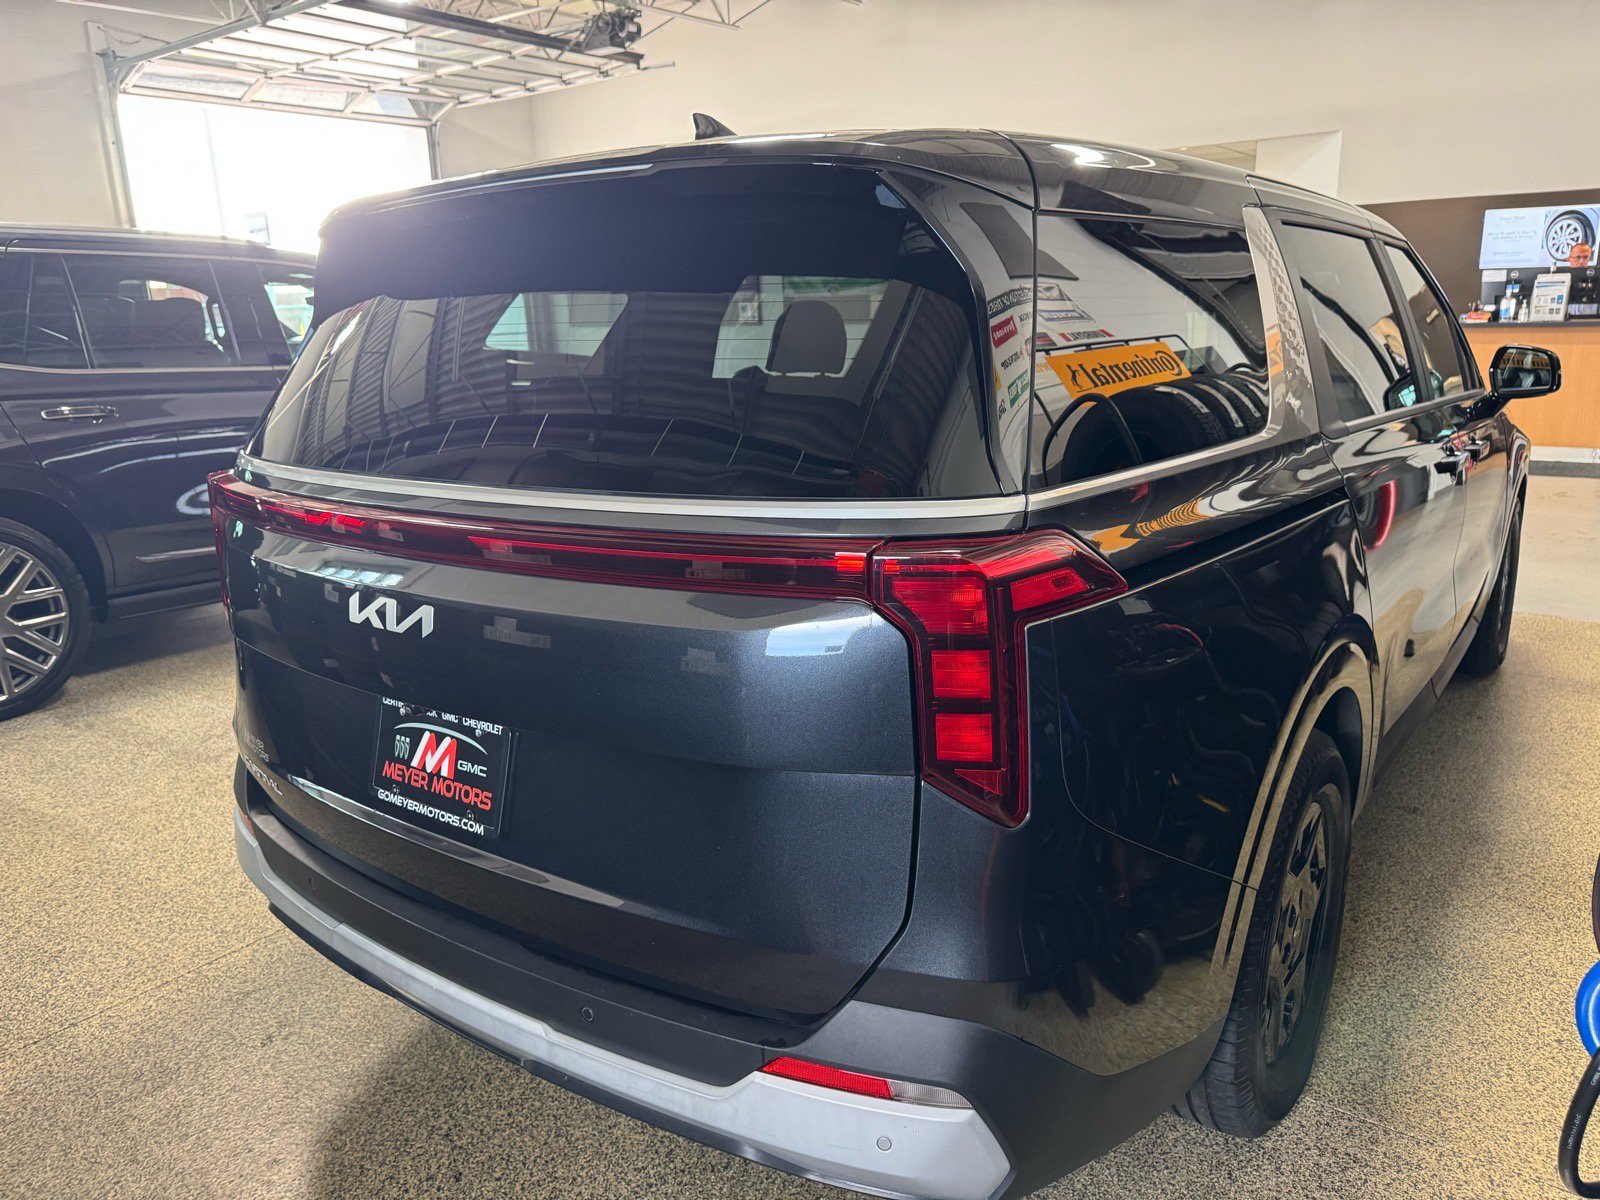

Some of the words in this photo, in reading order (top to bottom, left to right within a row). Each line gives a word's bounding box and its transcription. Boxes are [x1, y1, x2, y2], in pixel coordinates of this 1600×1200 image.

[462, 717, 504, 736] CHEVROLET
[382, 759, 429, 791] MEYER
[431, 772, 493, 811] MOTORS
[457, 759, 488, 778] GMC
[377, 789, 484, 836] GOMEYERMOTORS.COM
